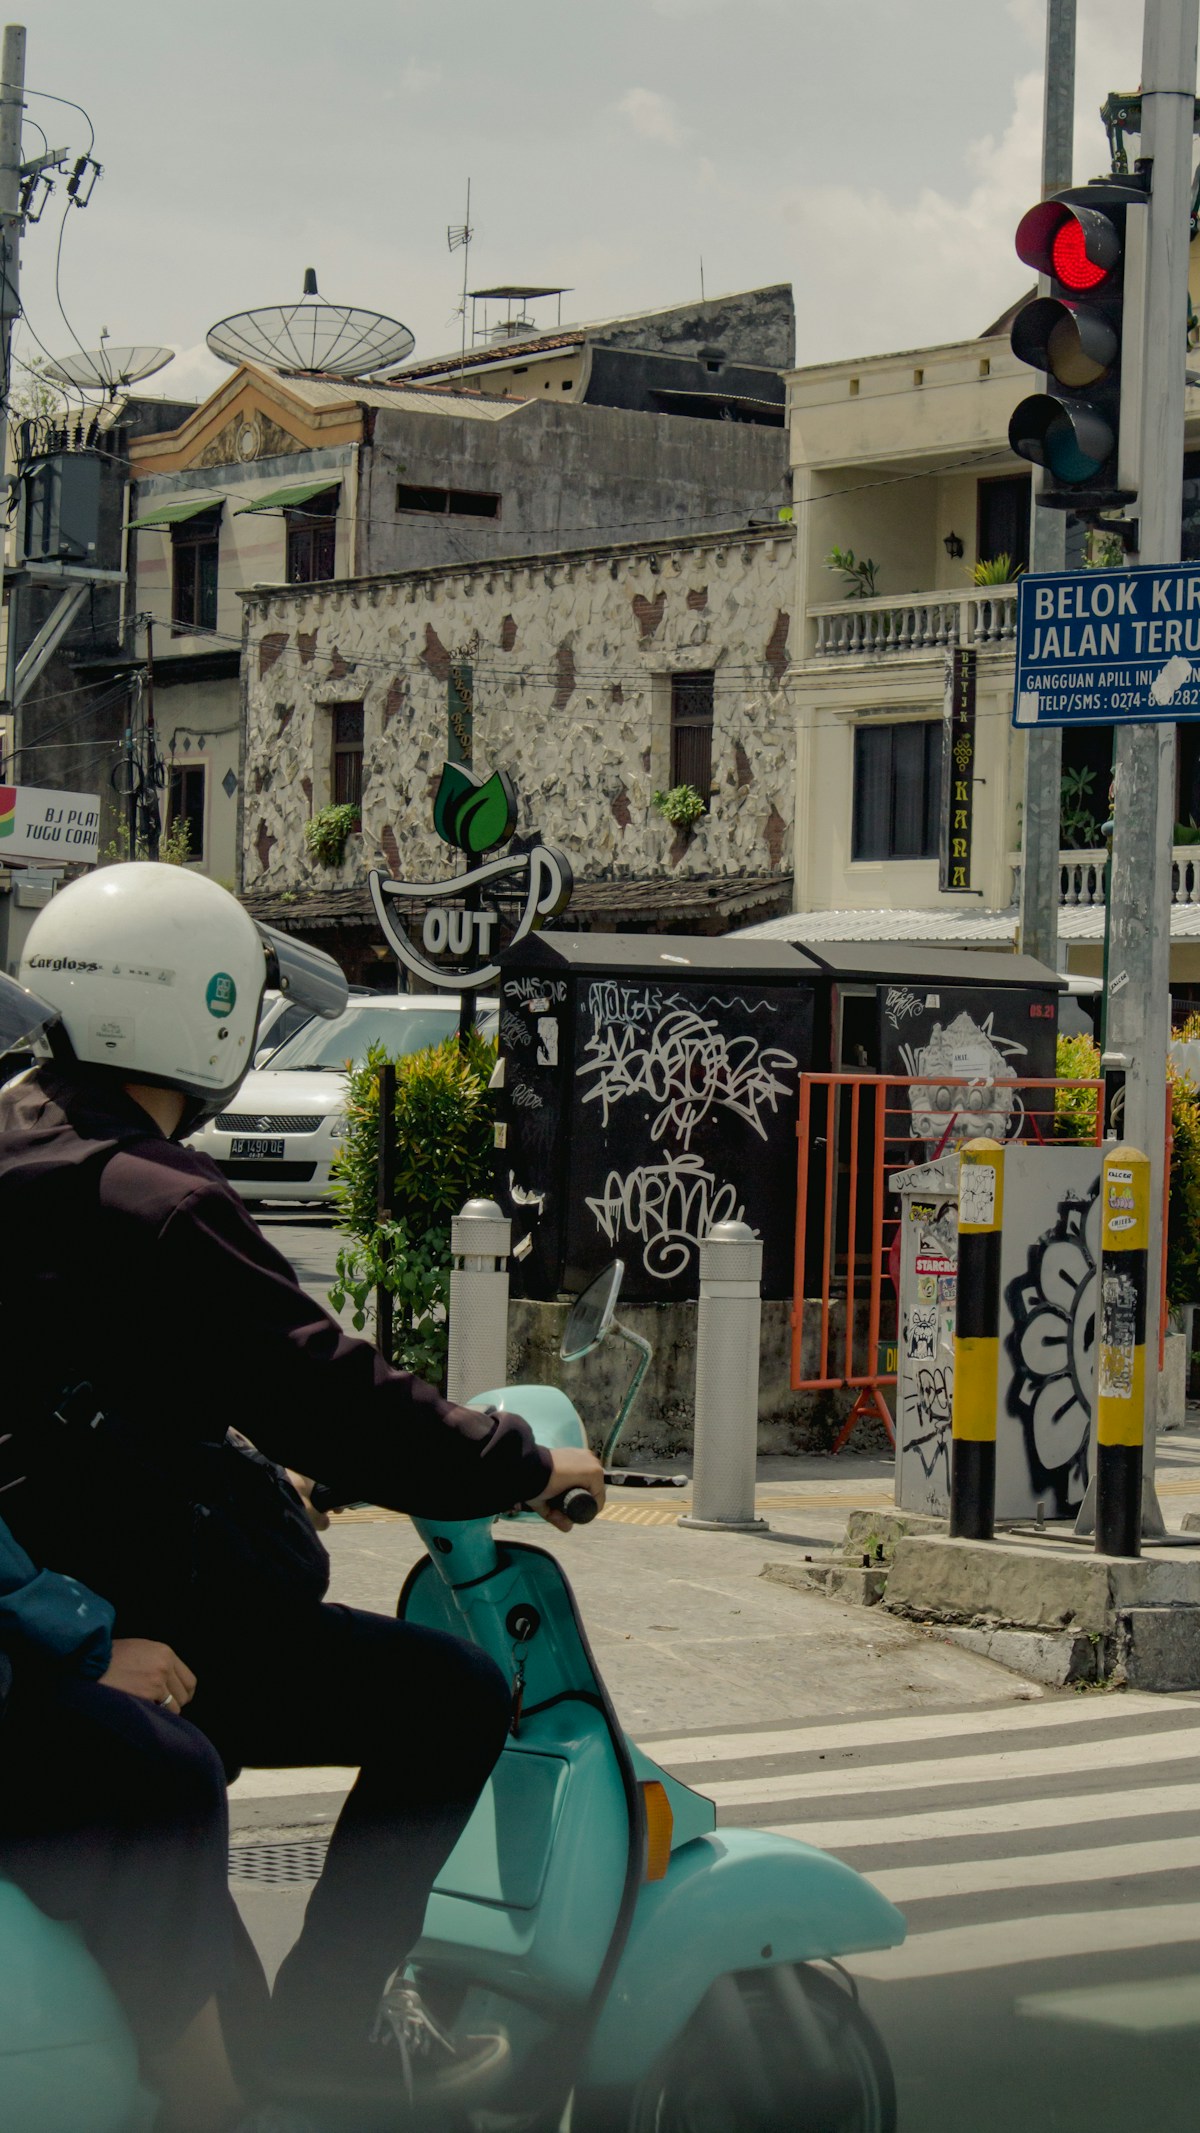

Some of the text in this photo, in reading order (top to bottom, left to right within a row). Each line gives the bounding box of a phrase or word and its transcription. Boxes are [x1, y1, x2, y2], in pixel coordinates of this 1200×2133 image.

[1034, 577, 1200, 620] BELOK KIR
[1028, 618, 1200, 660] JALAN TERU
[1026, 672, 1094, 690] GANGGUAN
[1098, 670, 1132, 687] APILL
[1135, 669, 1153, 686] INI
[1040, 693, 1101, 712] TELP/SMS
[45, 808, 63, 823] BJ
[26, 824, 62, 842] TUGU
[423, 909, 498, 955] OUT
[232, 1140, 244, 1153] AB
[247, 1141, 268, 1153] 1490
